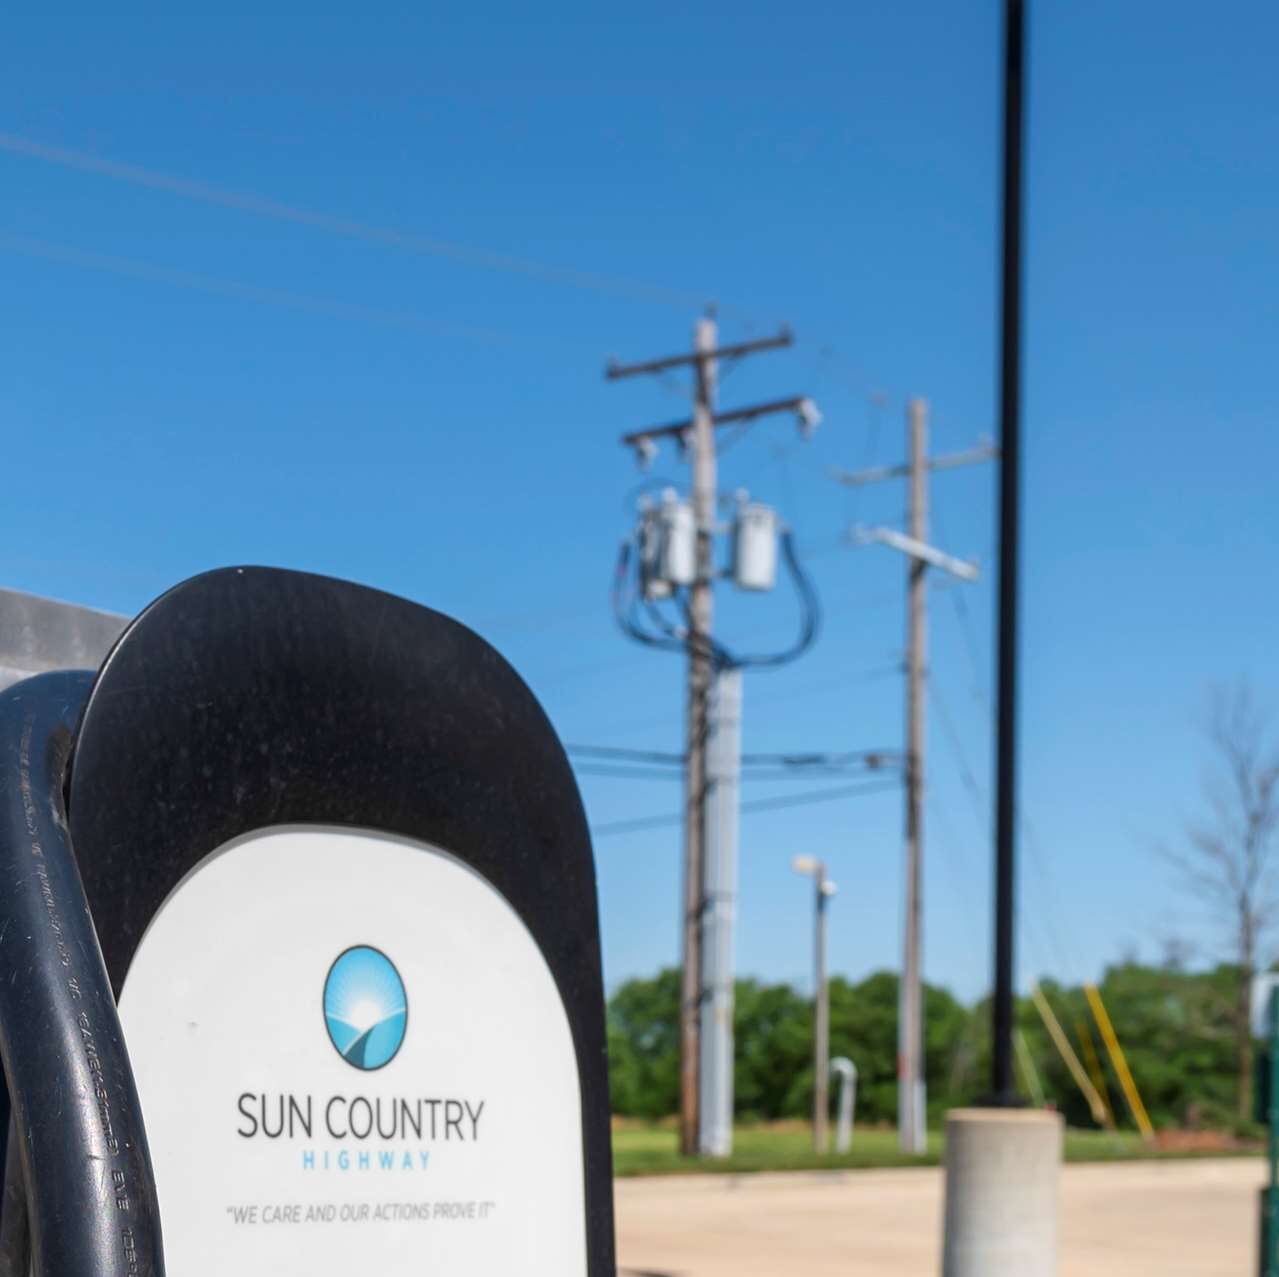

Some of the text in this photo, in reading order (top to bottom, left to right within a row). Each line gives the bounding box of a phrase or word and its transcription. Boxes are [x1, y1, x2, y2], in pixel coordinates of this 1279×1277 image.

[236, 1092, 485, 1141] SUN COUNTRY
[302, 1149, 431, 1171] HIGHWAY
[261, 1204, 301, 1224] CARE
[304, 1204, 337, 1223] AND
[339, 1203, 370, 1222] OUR
[373, 1202, 430, 1221] ACTIONS
[432, 1201, 476, 1219] PROVE
